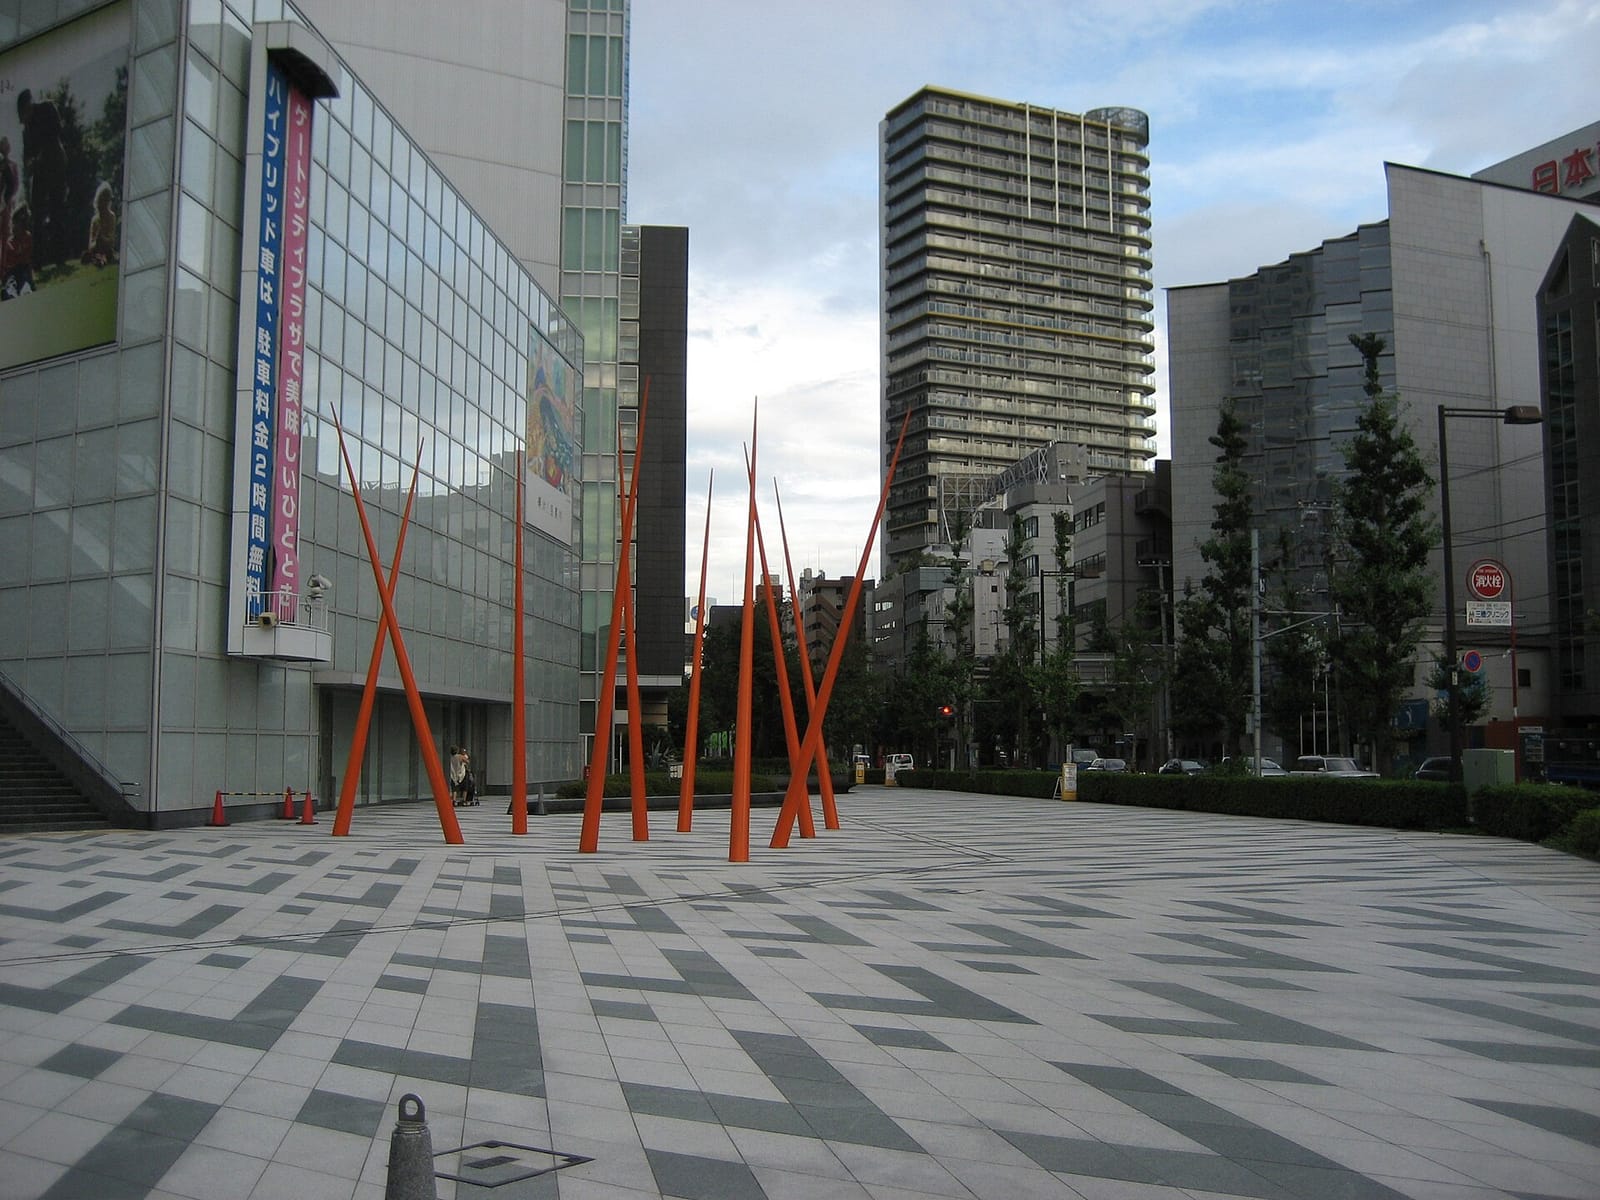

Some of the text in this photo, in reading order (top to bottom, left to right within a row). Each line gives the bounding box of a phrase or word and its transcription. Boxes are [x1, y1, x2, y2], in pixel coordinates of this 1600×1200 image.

[1533, 141, 1600, 195] 日本
[1475, 574, 1502, 588] 消火栓
